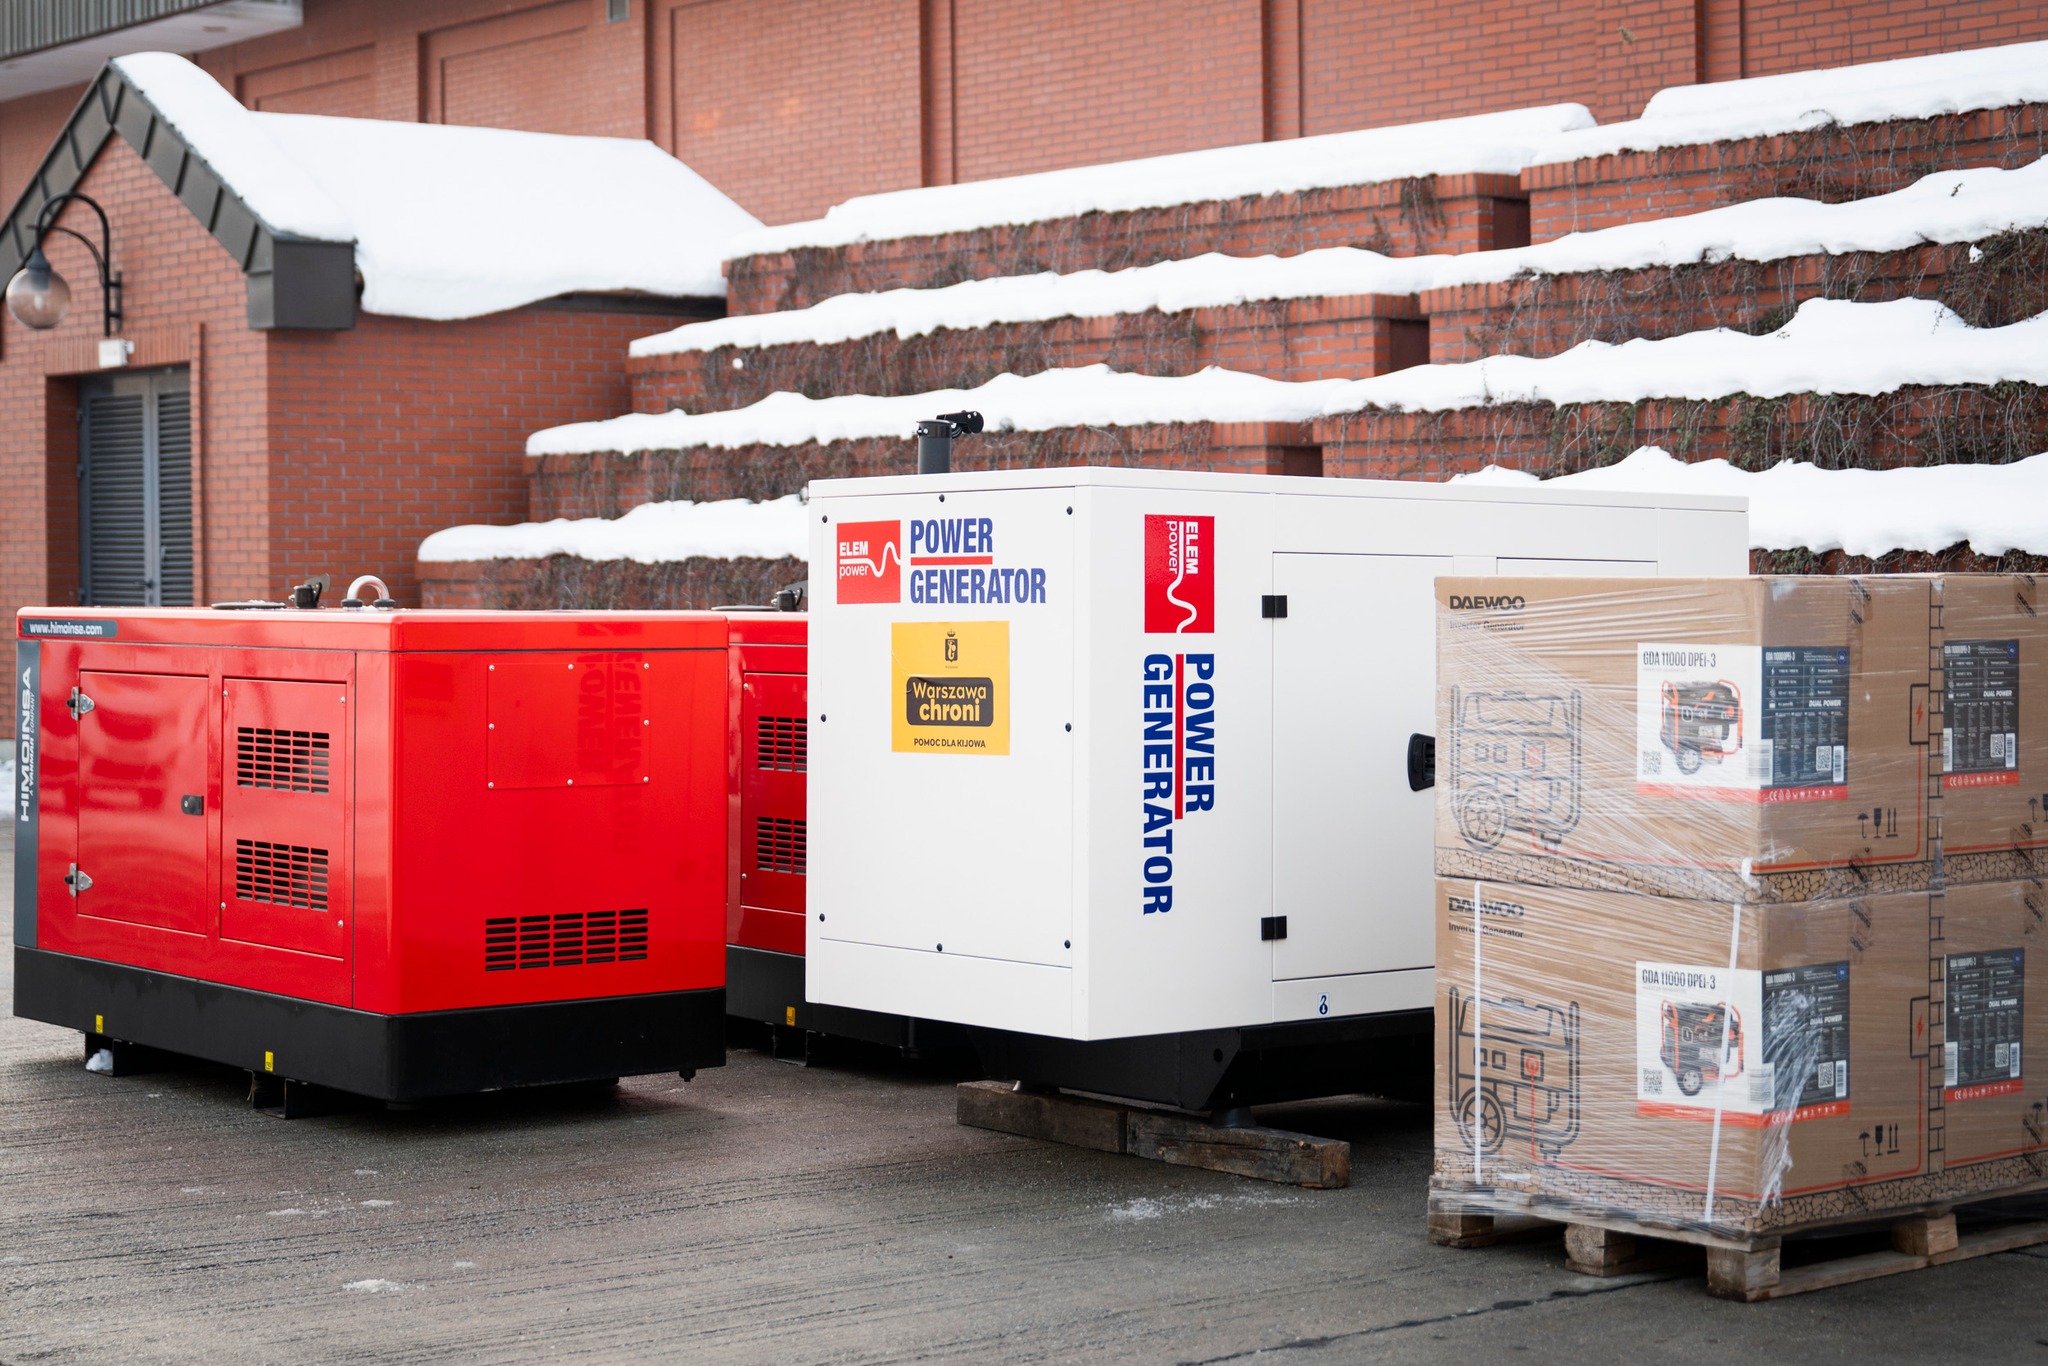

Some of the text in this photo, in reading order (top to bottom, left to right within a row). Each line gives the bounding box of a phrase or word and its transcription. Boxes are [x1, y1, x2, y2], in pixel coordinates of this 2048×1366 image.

[910, 518, 993, 554] POWER
[839, 541, 869, 556] ELEM
[1166, 520, 1178, 574] power
[1185, 521, 1199, 574] ELEM
[839, 563, 869, 580] power
[910, 568, 1047, 604] GENERATOR
[1449, 595, 1526, 610] DAEWOO
[29, 621, 103, 635] www.himoinsa.com
[1643, 651, 1660, 666] GDA
[1662, 651, 1687, 667] 11000
[912, 682, 987, 700] Warszawa
[919, 698, 980, 722] chroni
[1823, 699, 1842, 707] POWER
[1185, 653, 1215, 813] POWER
[20, 667, 31, 822] HIMOINSA
[914, 738, 986, 748] POMOC DLA KIJOWA
[1143, 653, 1174, 916] GENERATOR
[1448, 896, 1525, 918] DAWOO
[1482, 925, 1525, 938] Generator
[1642, 969, 1659, 984] GDA
[1661, 970, 1686, 987] 11000
